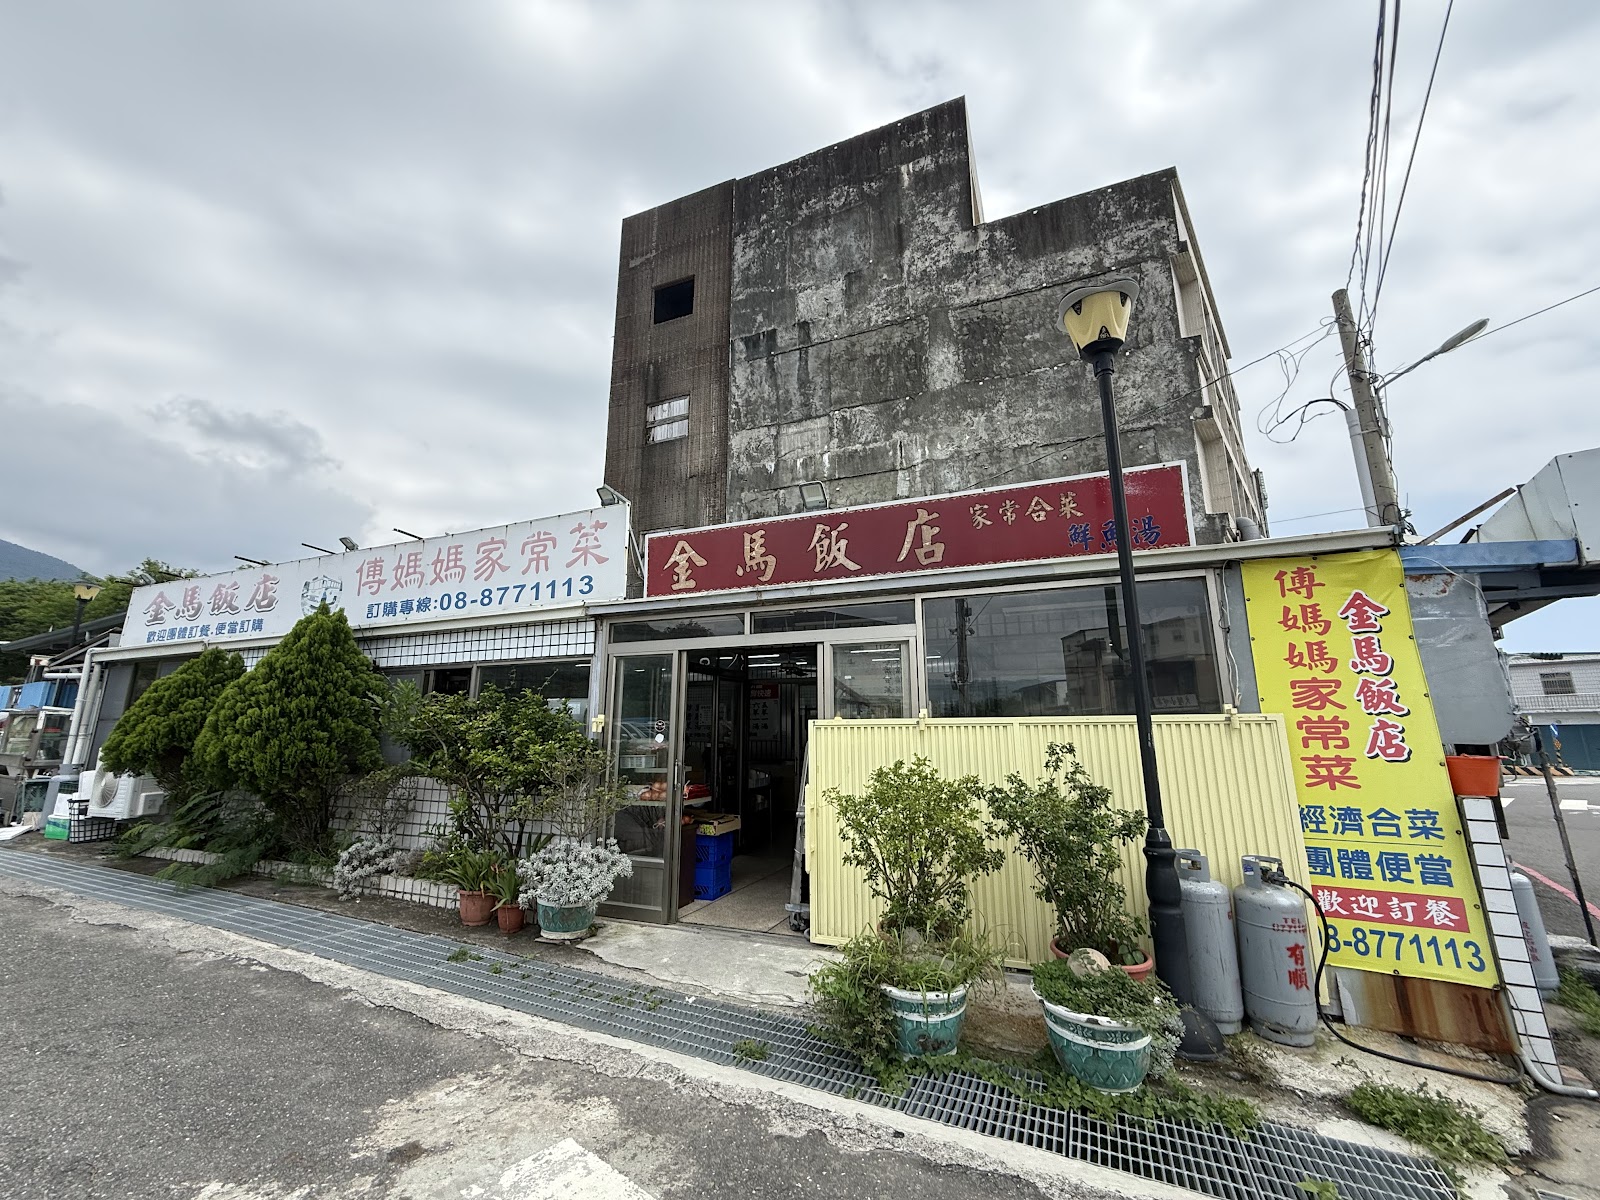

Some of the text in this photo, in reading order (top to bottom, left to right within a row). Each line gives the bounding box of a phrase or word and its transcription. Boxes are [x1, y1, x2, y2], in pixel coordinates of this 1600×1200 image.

[970, 491, 1084, 529] 家常合菜
[356, 520, 609, 596] 傅媽媽家常菜
[663, 508, 946, 591] 金馬飯店
[143, 573, 280, 626] 金馬飯店
[1273, 564, 1362, 791] 傅媽媽家常菜
[1337, 588, 1412, 763] 金馬飯店
[1298, 804, 1445, 840] 經濟合菜
[1305, 846, 1453, 888] 團體便當
[1316, 889, 1460, 927] 歡迎訂餐
[1318, 924, 1486, 973] 8-8771113
